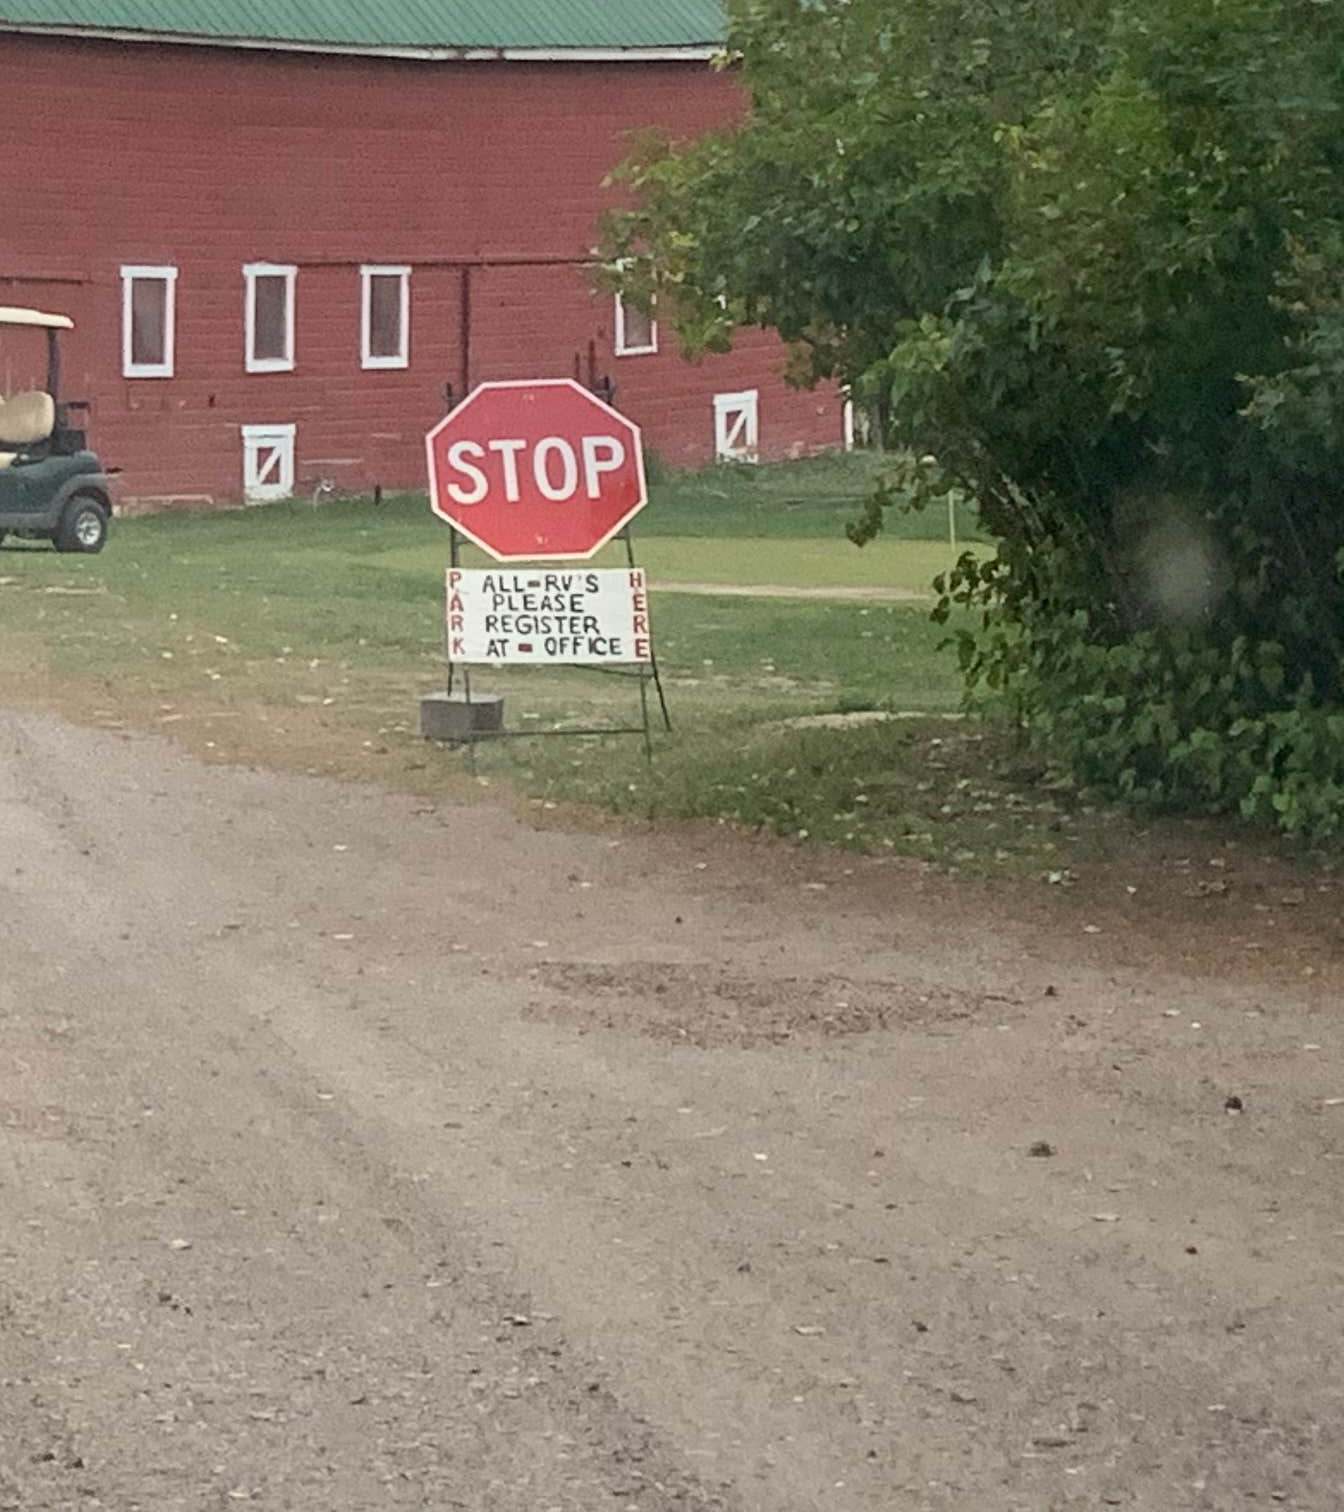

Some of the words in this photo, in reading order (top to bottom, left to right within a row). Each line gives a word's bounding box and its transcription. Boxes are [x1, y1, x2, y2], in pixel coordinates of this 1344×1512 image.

[447, 435, 626, 504] STOP
[492, 593, 585, 613] PLEASE
[485, 614, 601, 635] REGISTER
[486, 638, 510, 658] AT
[543, 636, 623, 656] OFFICE
